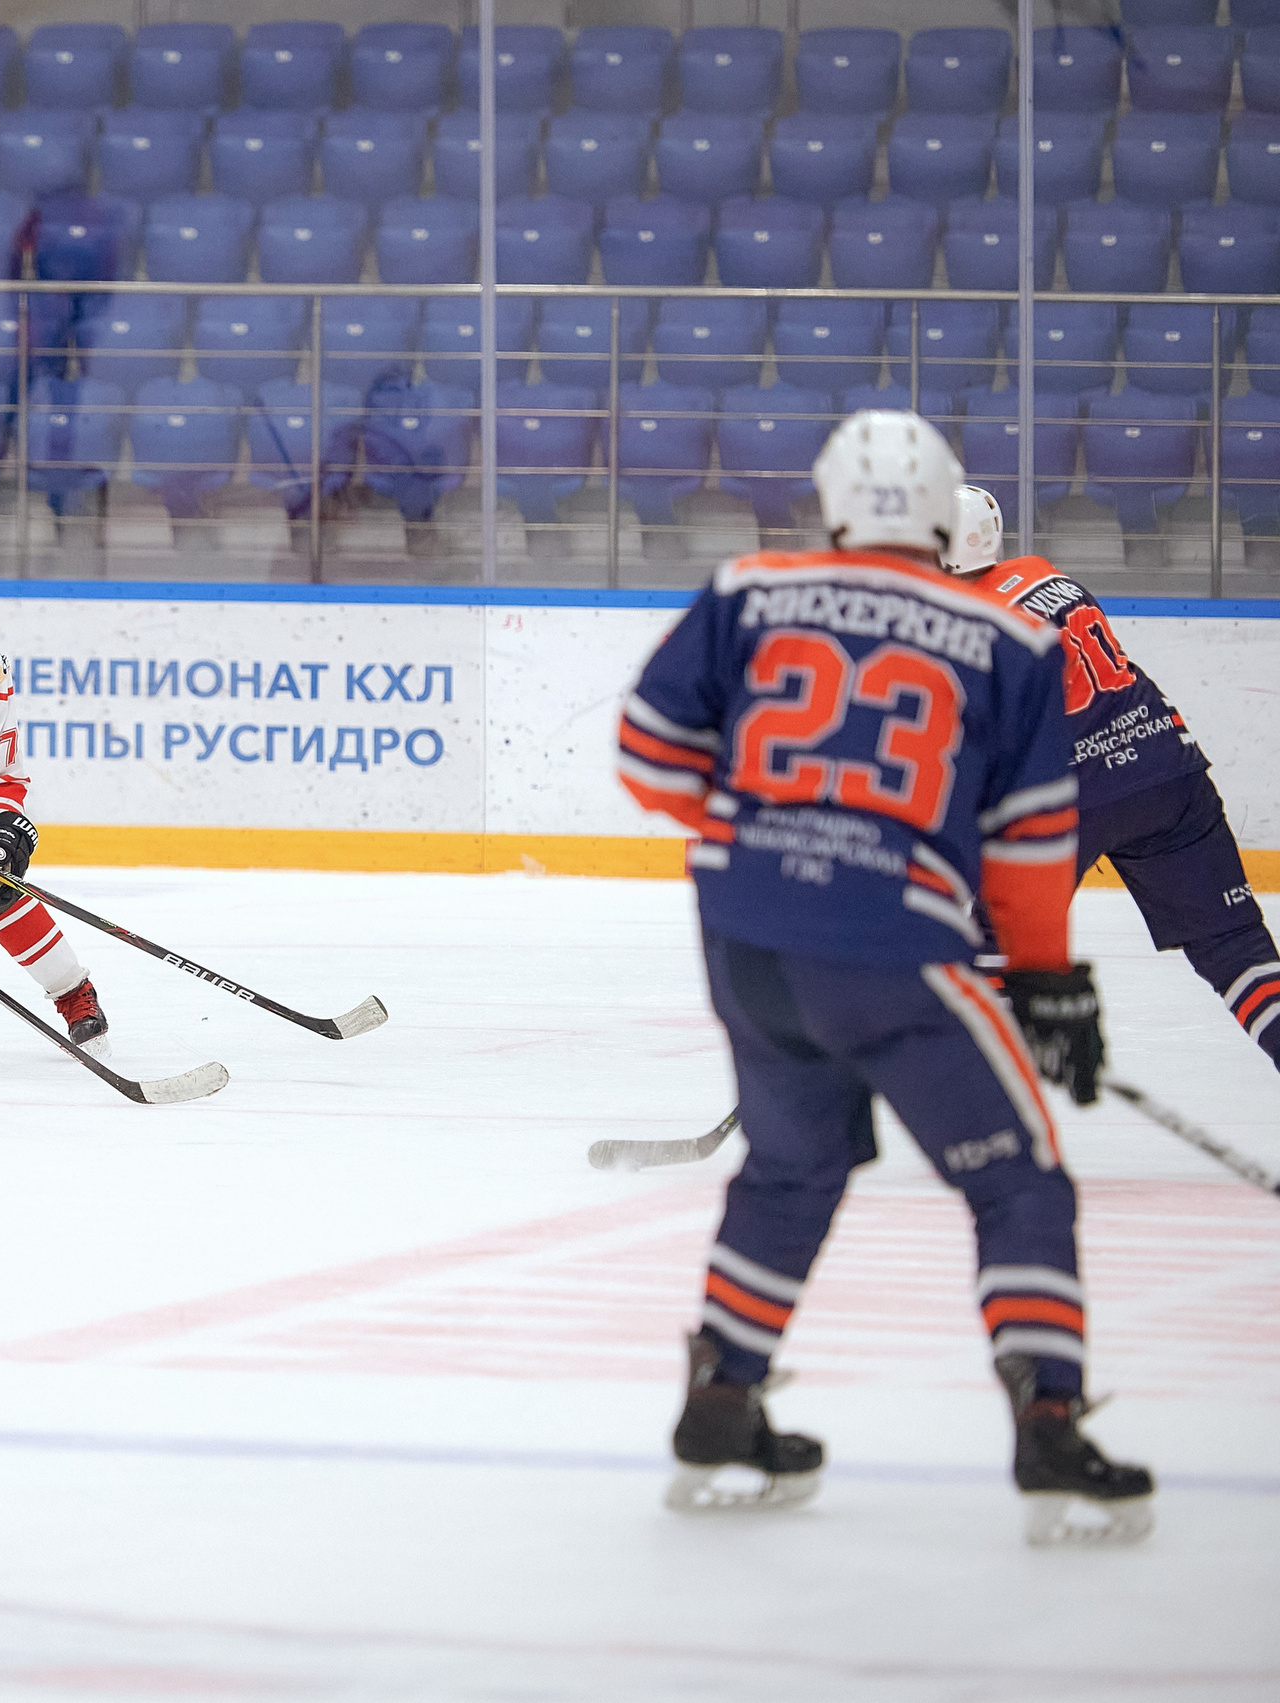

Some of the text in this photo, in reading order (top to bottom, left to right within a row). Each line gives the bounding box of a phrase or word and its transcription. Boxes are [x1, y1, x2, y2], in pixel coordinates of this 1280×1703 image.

[346, 663, 454, 703] КХЛ
[19, 720, 444, 773] ППЫ РУСГИДРО
[728, 628, 968, 834] 23
[1104, 748, 1139, 770] ГЭС
[163, 953, 256, 1002] BAUER
